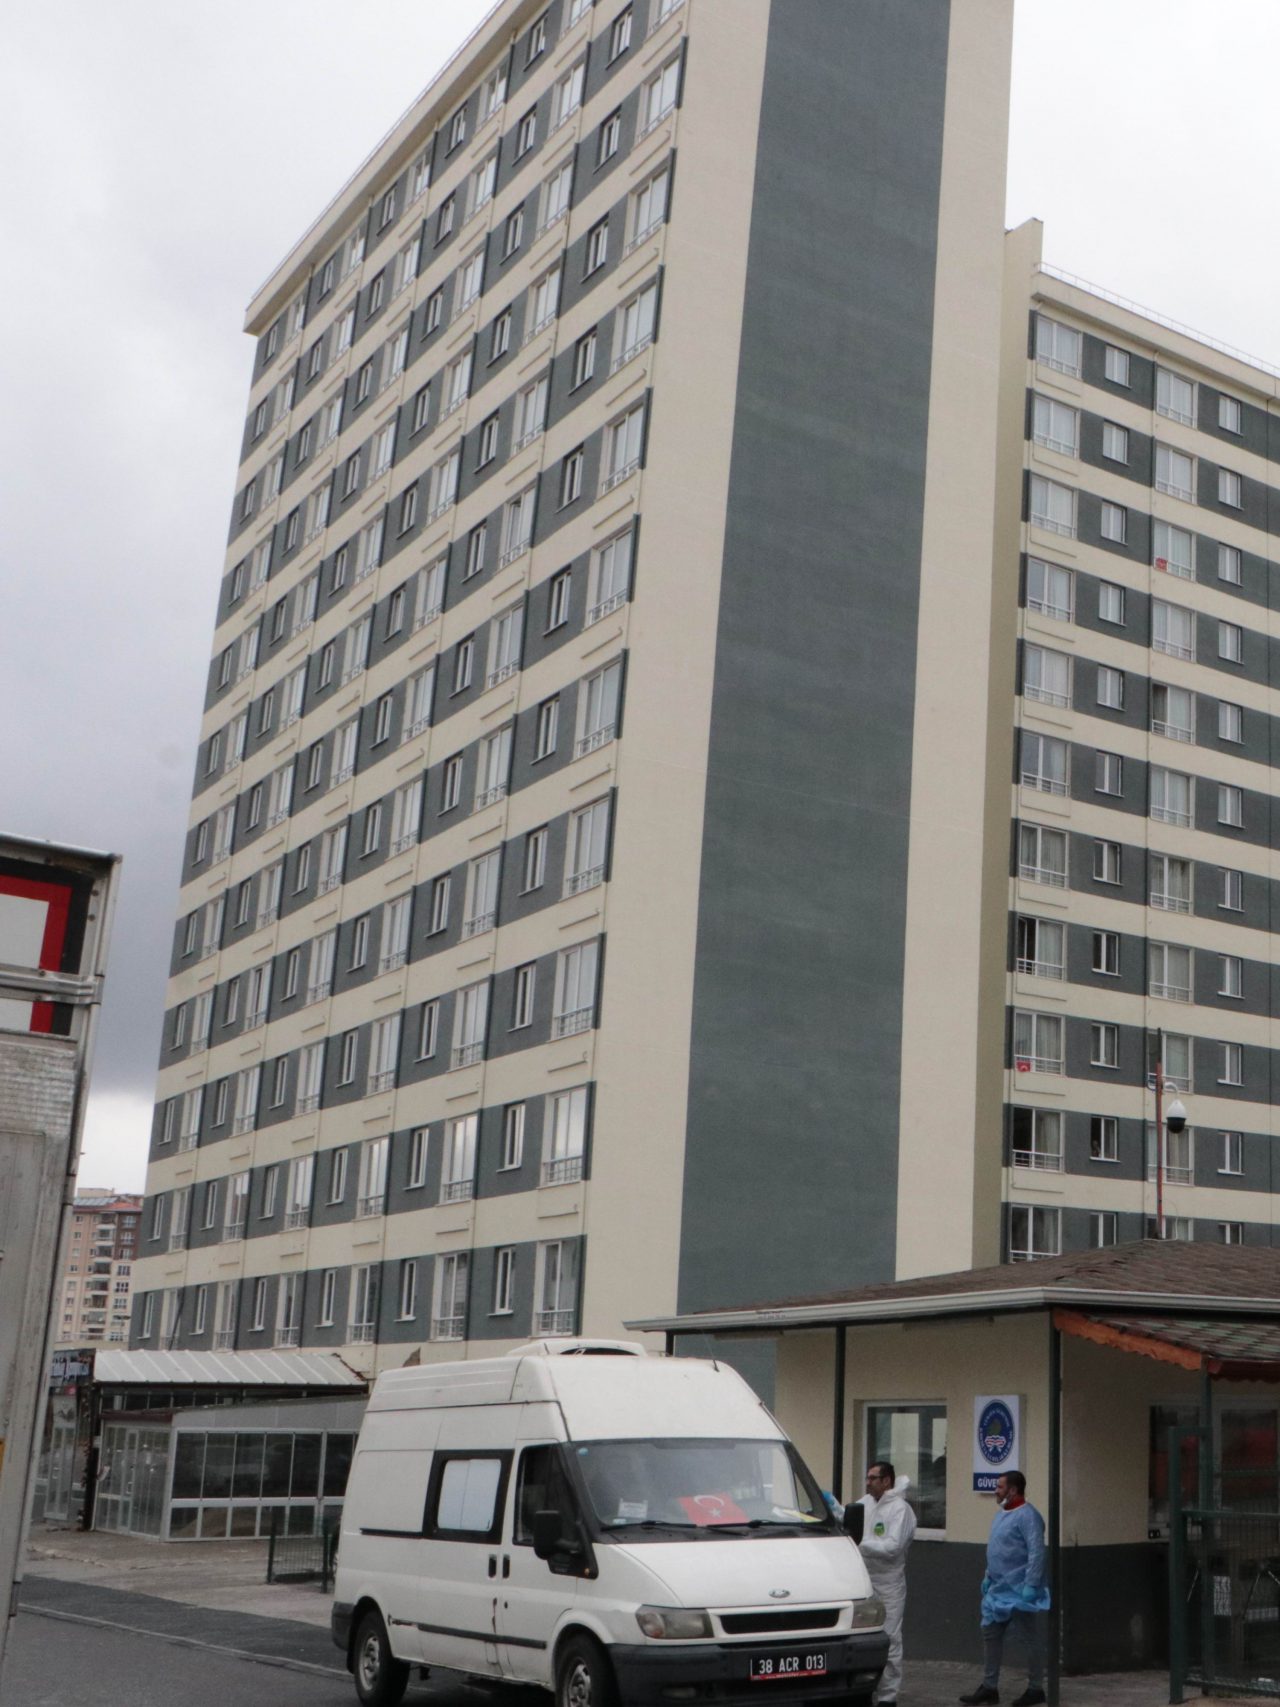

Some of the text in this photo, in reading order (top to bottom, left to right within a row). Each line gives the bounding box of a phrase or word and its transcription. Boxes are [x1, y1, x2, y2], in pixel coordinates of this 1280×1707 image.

[977, 1477, 1000, 1488] GÜVE
[759, 1659, 773, 1674] 38
[779, 1656, 799, 1673] ACR
[806, 1654, 824, 1670] 013
